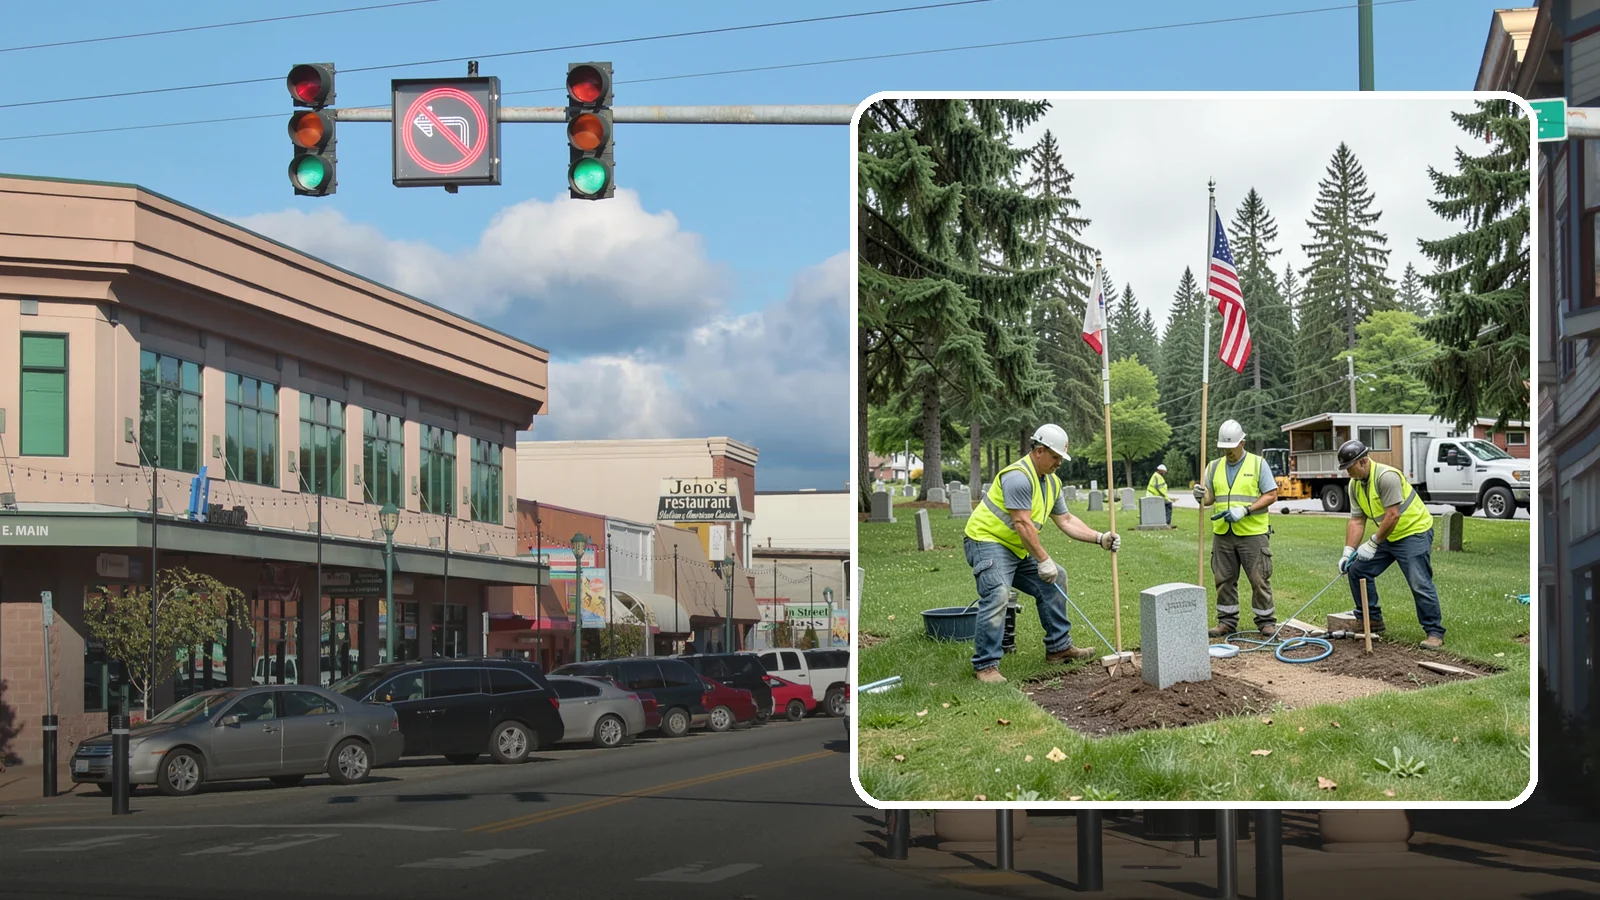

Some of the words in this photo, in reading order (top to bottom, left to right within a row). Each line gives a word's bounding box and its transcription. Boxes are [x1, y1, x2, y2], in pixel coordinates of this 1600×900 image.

[670, 480, 727, 494] Jeno's
[665, 496, 731, 509] restaurant
[659, 510, 681, 519] Italian
[686, 510, 714, 519] American
[715, 509, 737, 519] Cuisine
[2, 525, 13, 536] E.
[15, 525, 49, 536] MAIN
[797, 608, 828, 616] Street
